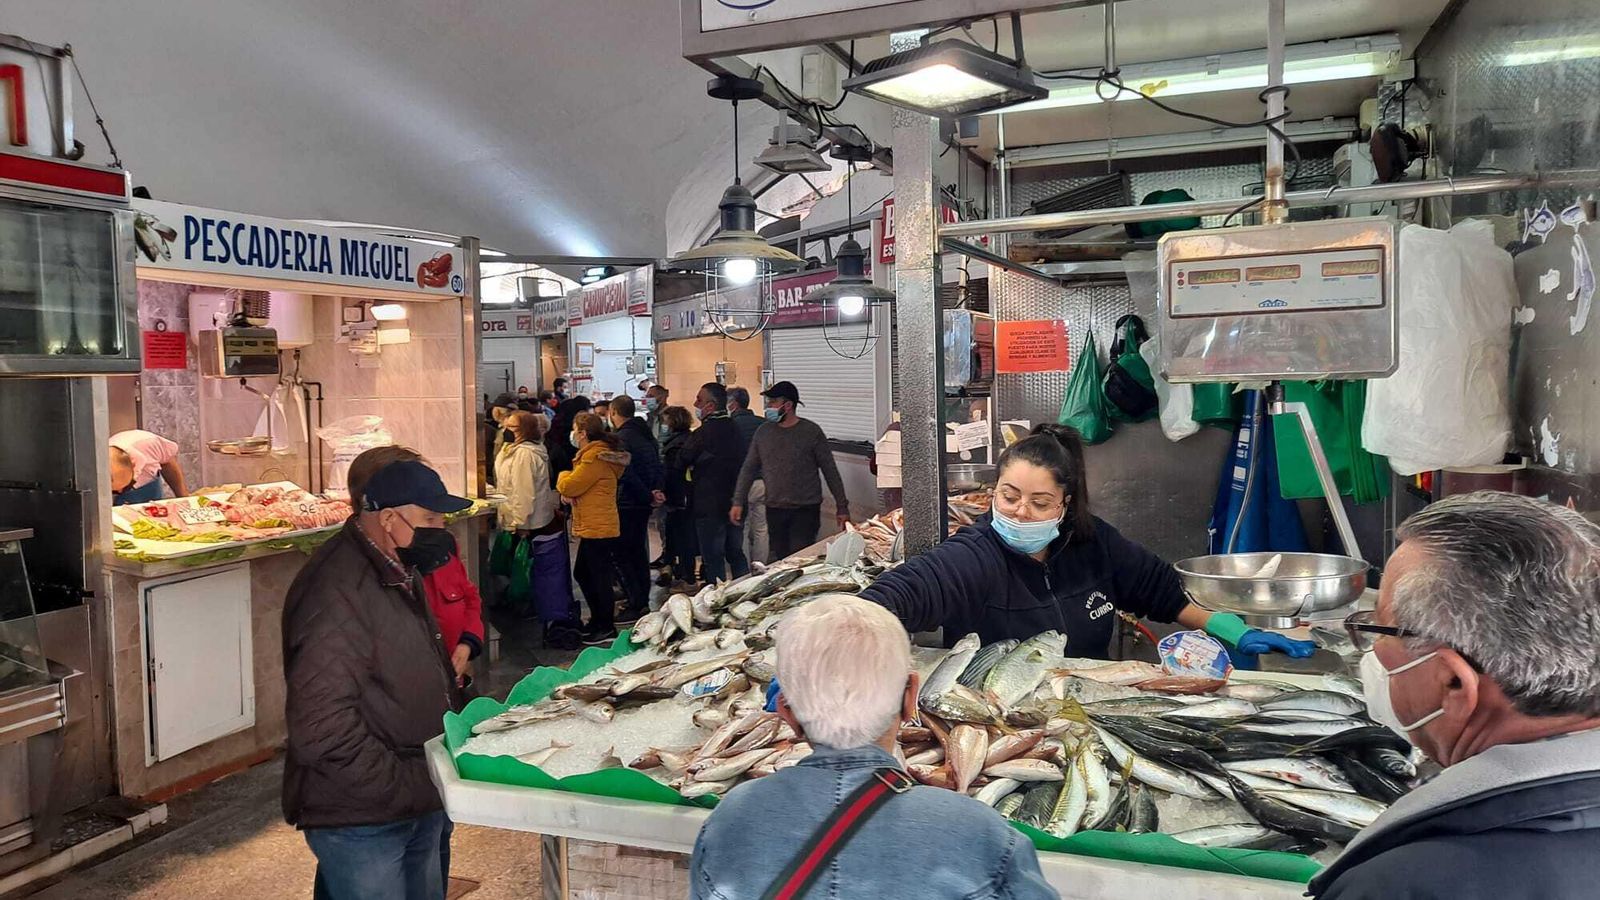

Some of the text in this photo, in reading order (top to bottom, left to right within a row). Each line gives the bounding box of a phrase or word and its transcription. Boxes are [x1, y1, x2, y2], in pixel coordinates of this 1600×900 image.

[184, 215, 415, 283] PESCADERIA MIGUEL
[452, 278, 462, 290] 60
[778, 287, 804, 309] BAR
[1089, 602, 1114, 620] CURRO
